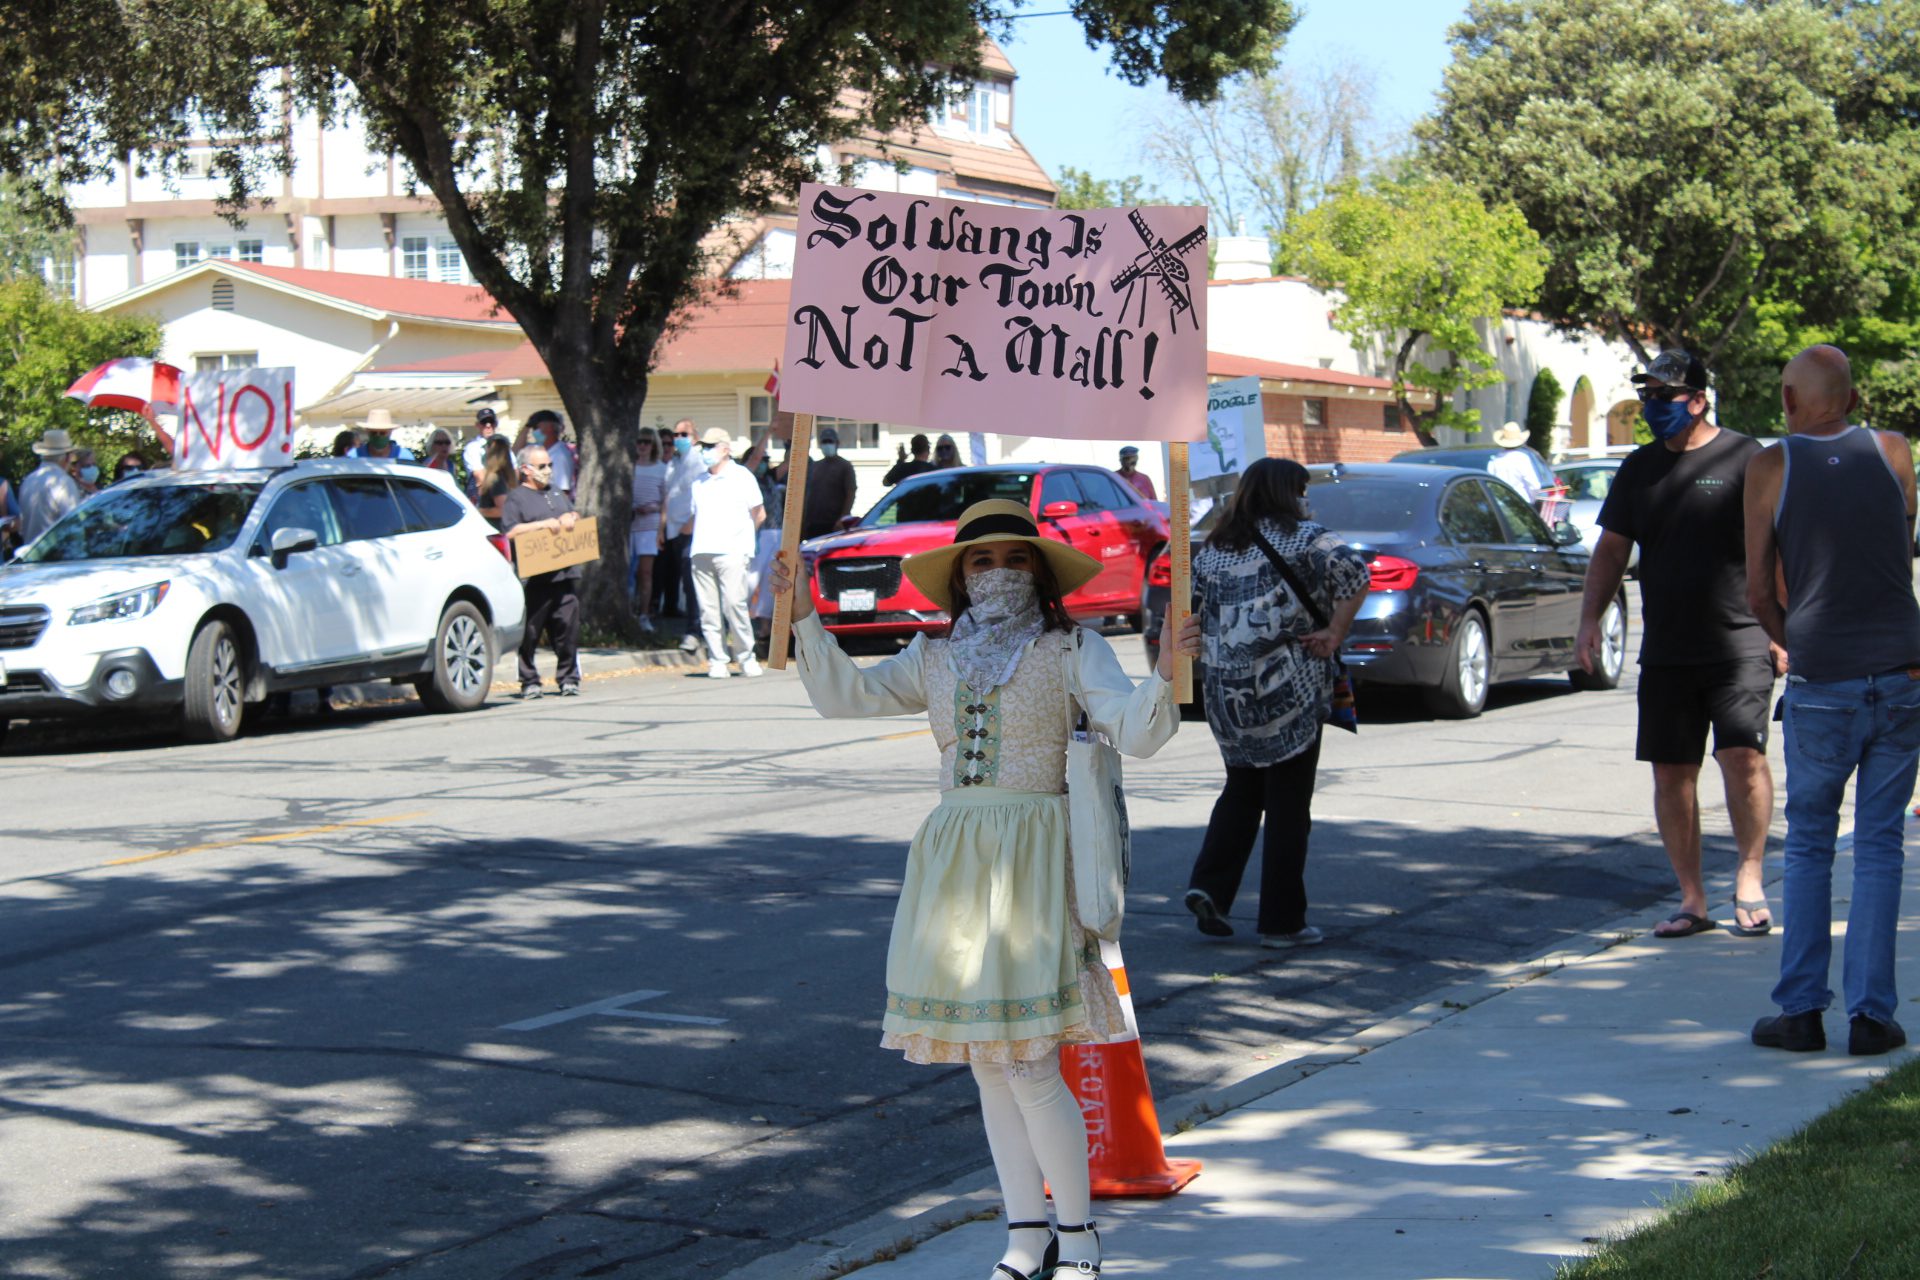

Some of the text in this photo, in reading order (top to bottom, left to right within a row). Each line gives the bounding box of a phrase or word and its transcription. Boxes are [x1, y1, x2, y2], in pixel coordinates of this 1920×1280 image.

[807, 189, 1052, 270] Solvang
[862, 255, 1104, 318] Our Town
[940, 333, 989, 382] A
[182, 381, 292, 461] NO!
[1078, 1052, 1105, 1160] ROADS
